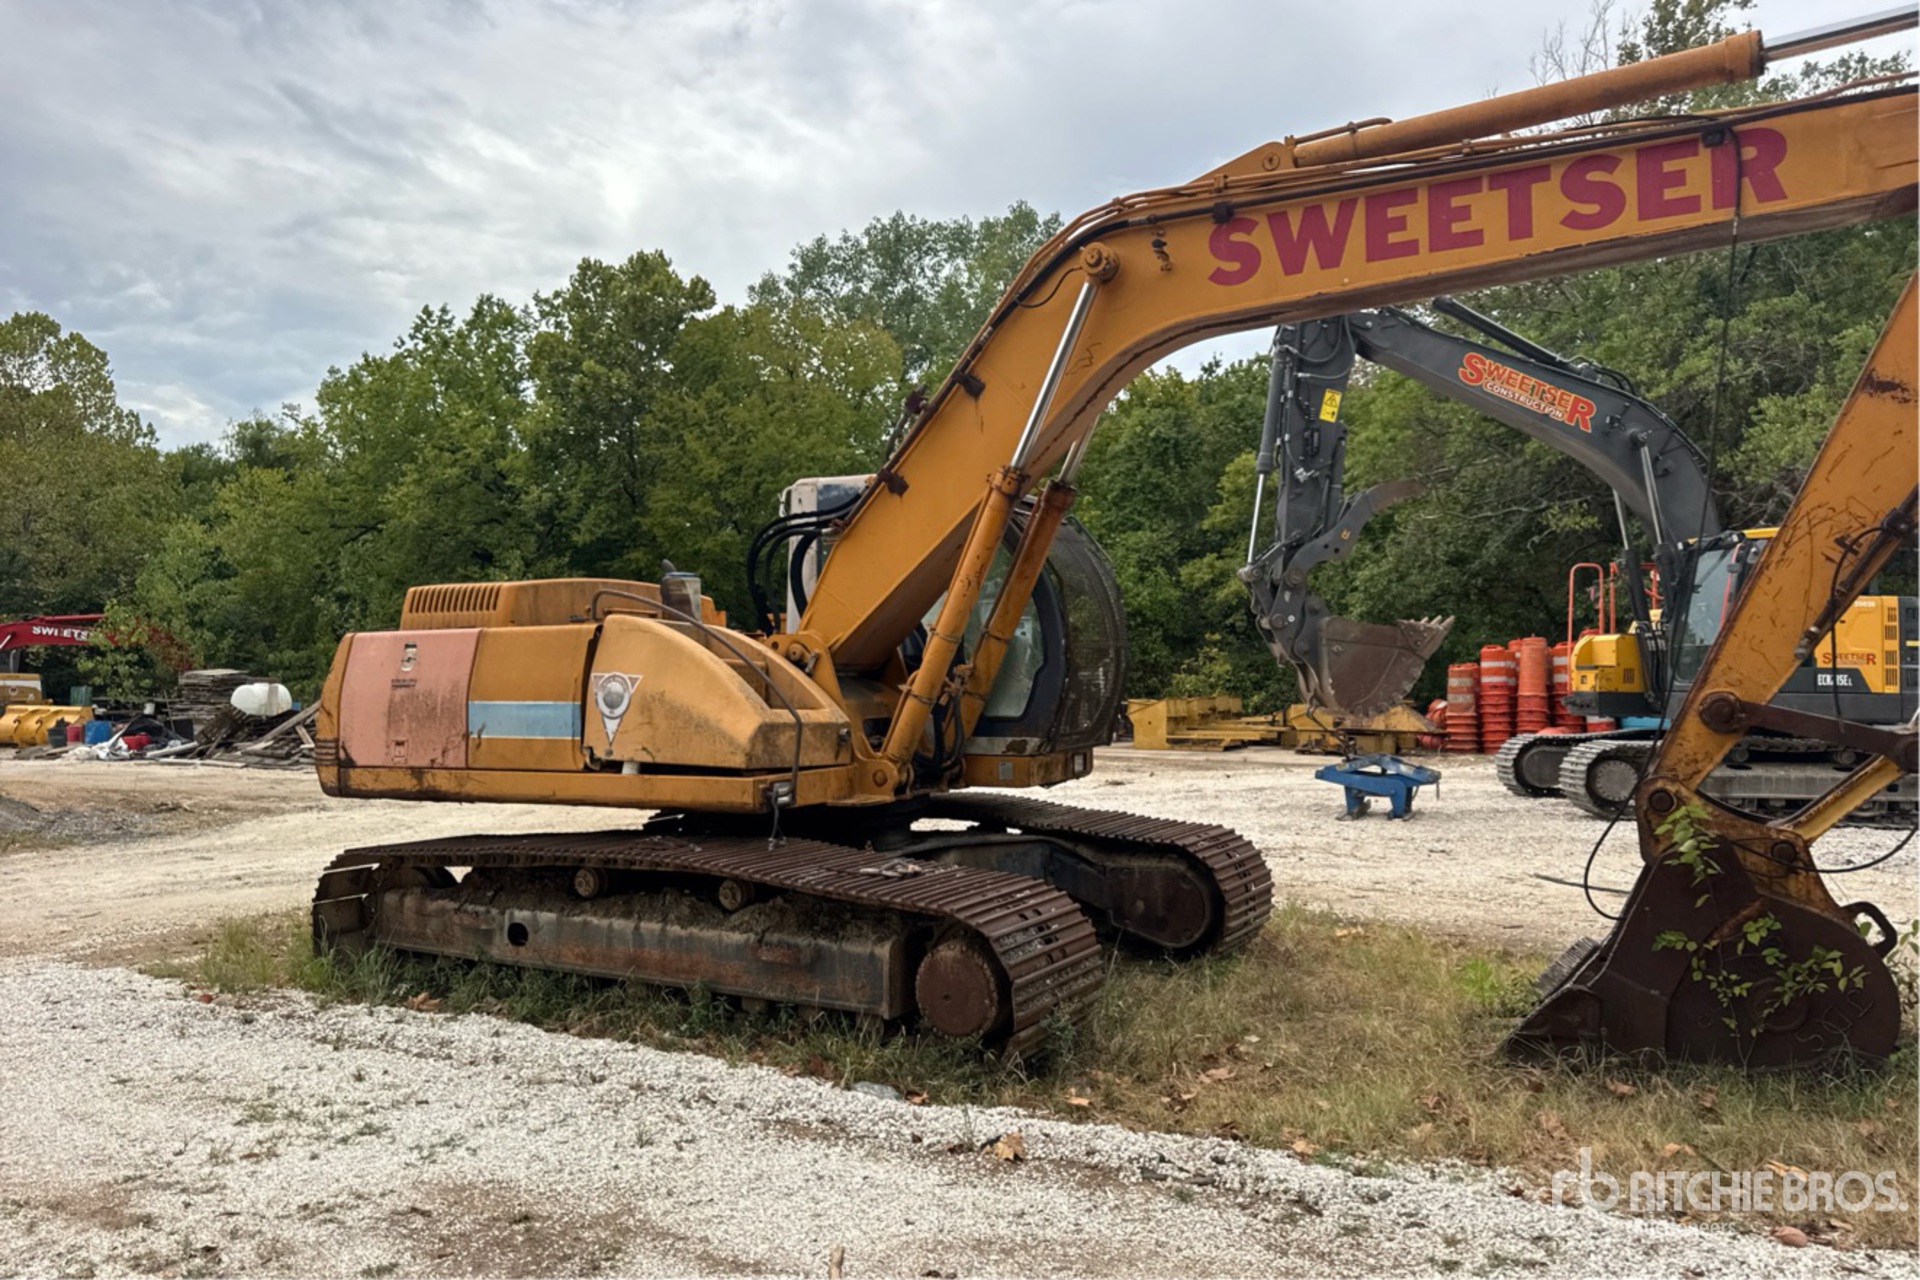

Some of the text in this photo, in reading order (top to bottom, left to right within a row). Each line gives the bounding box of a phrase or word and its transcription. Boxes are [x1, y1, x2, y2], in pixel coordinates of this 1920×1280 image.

[1207, 126, 1788, 286] SWEETSER
[1458, 352, 1597, 433] SWEETSER
[1484, 381, 1565, 419] CONSTRUCTION
